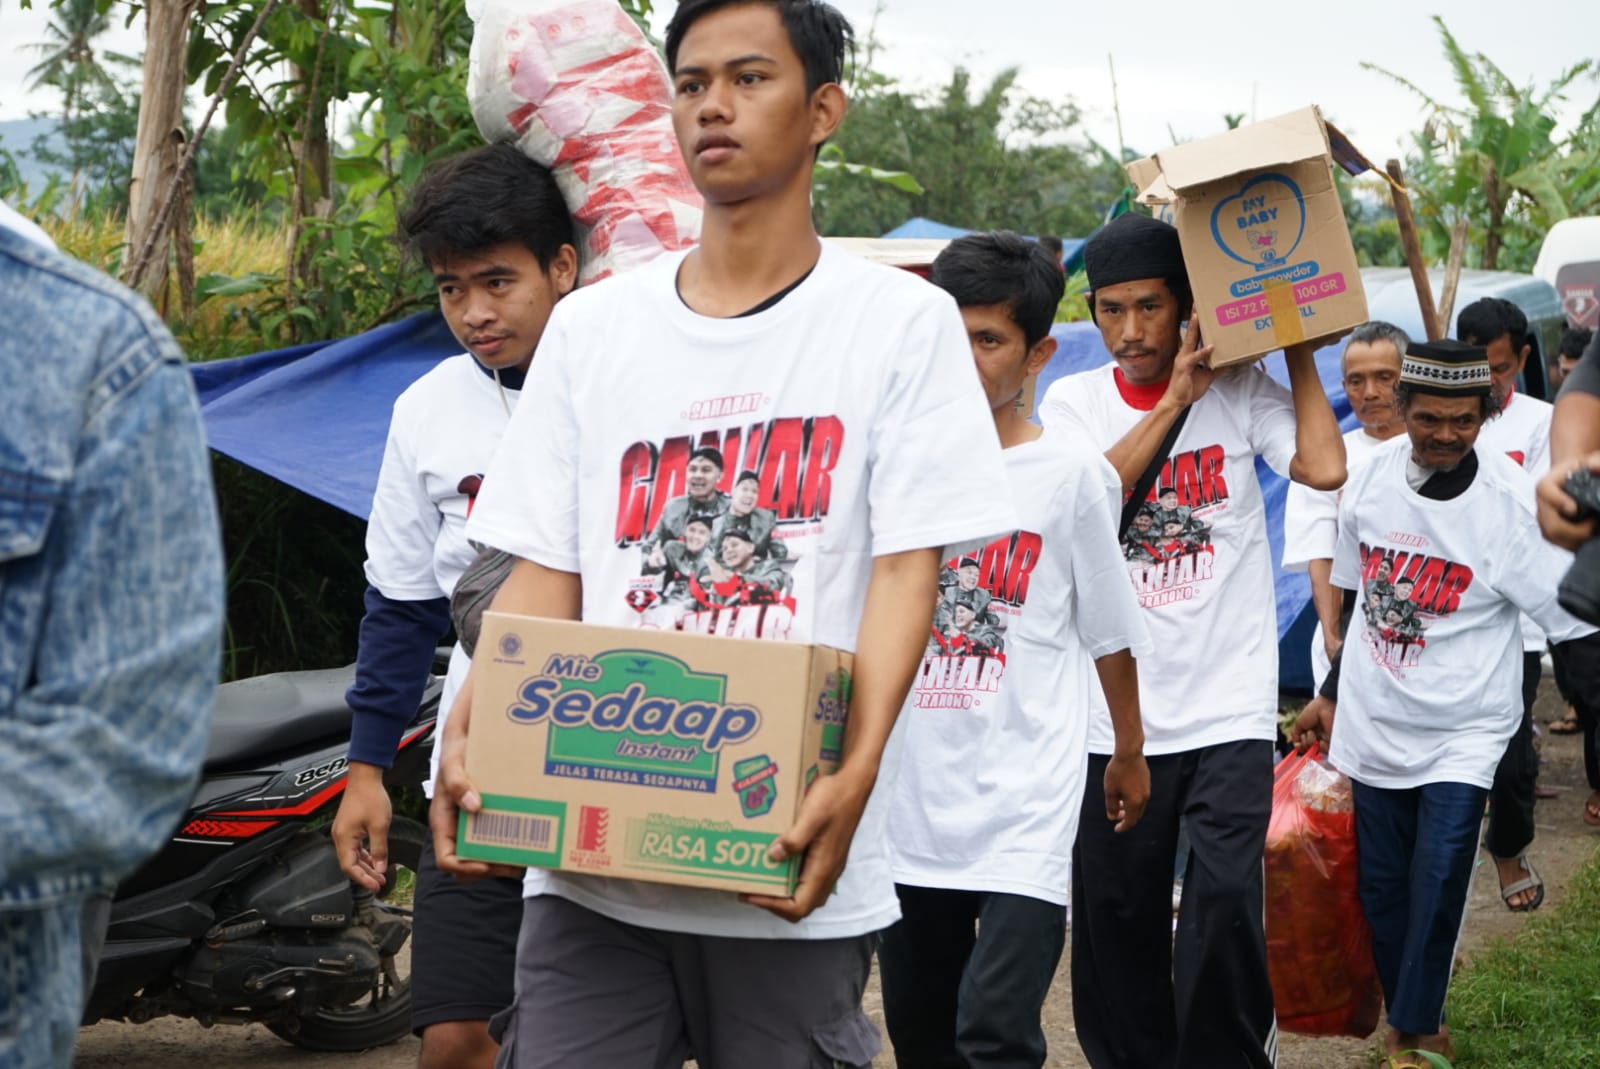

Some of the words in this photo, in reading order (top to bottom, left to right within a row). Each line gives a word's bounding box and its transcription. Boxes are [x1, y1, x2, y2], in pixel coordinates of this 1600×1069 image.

[1242, 195, 1265, 212] MY
[1237, 207, 1277, 229] BABY
[1225, 308, 1239, 320] ISI
[1242, 302, 1258, 316] 72
[1297, 285, 1318, 299] 100
[1321, 279, 1339, 293] GR
[544, 655, 602, 682] Mie
[509, 675, 759, 753] Sedaap
[615, 739, 700, 763] Instant
[295, 755, 349, 787] BeA
[552, 764, 589, 777] JELAS
[592, 768, 639, 784] TERASA
[643, 773, 708, 791] SEDAPNYA
[641, 831, 706, 862] RASA
